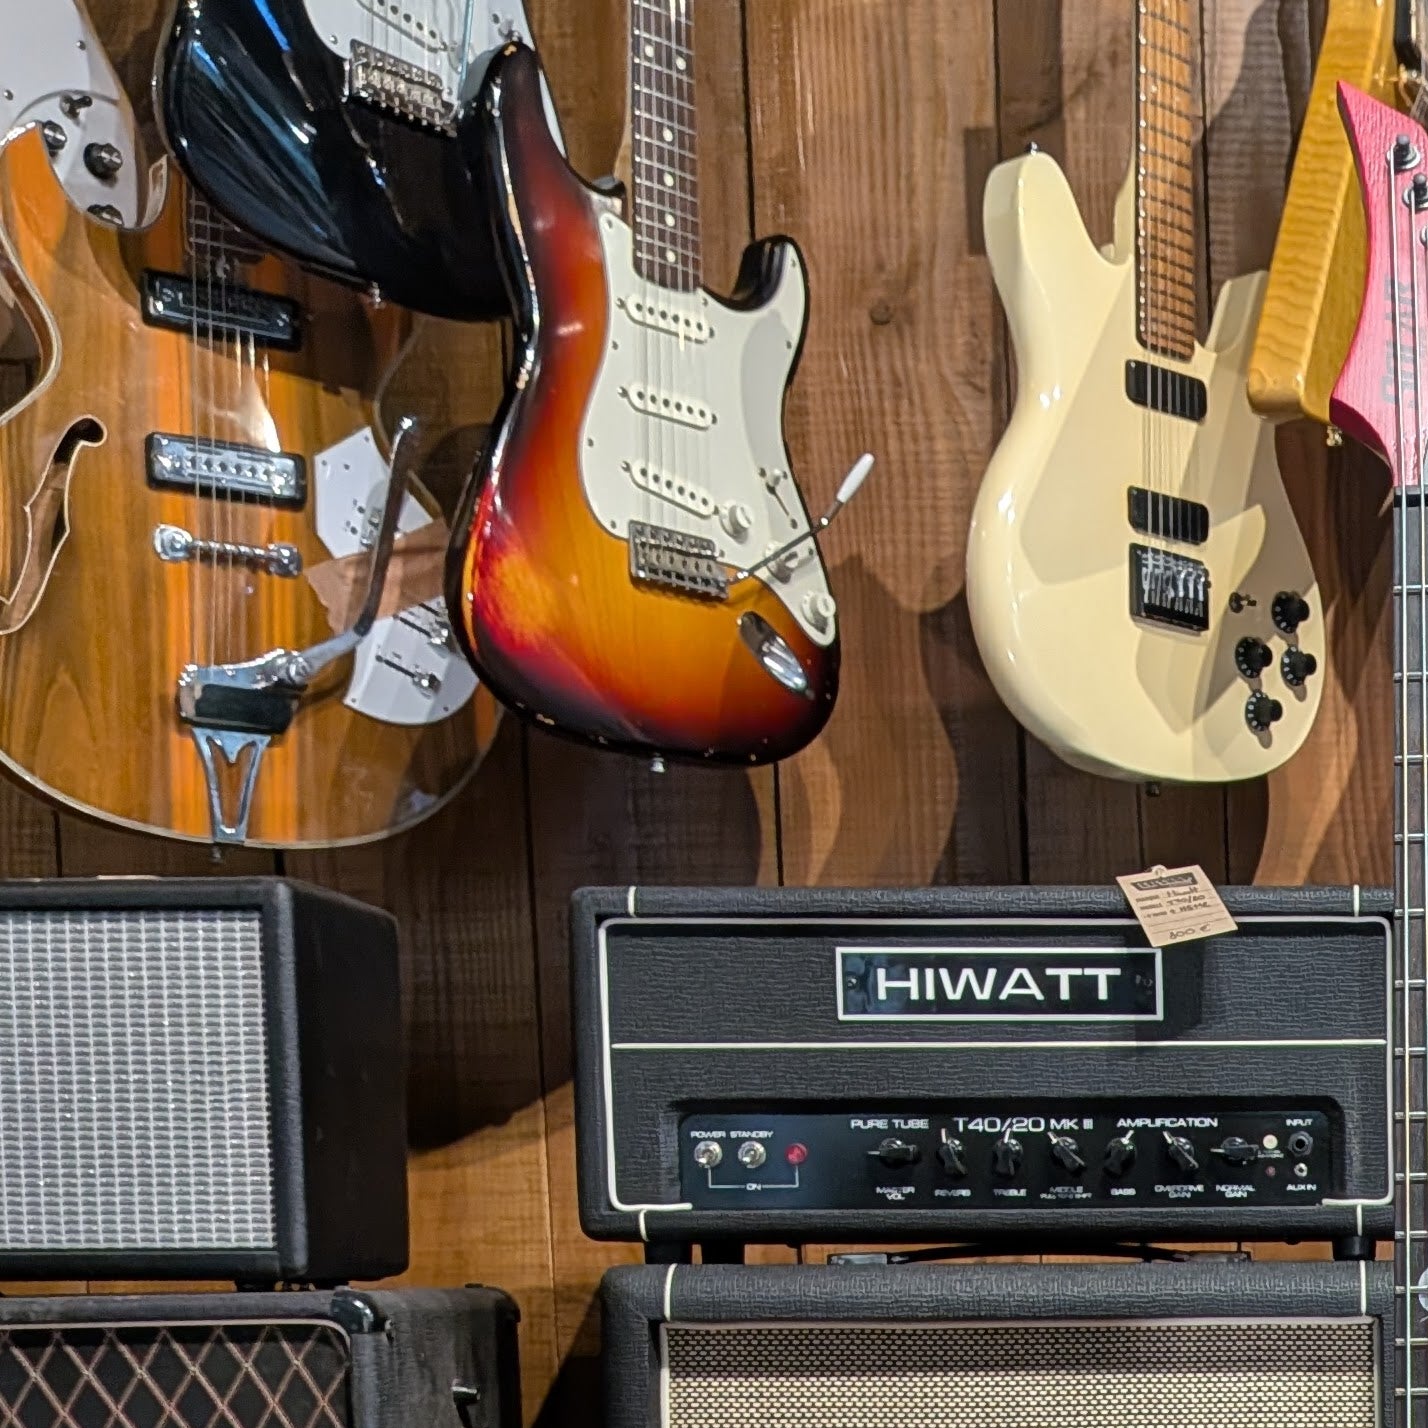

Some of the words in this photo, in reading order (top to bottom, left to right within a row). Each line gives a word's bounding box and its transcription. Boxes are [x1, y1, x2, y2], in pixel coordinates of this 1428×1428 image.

[1169, 927, 1196, 940] 800
[877, 967, 1121, 1001] HIWATT
[850, 1118, 888, 1129] PURE
[892, 1118, 930, 1129] TUBE
[952, 1117, 1045, 1133] T40/20
[1050, 1118, 1078, 1130] MK
[1116, 1117, 1219, 1128] AMPLIFICATION
[1286, 1118, 1313, 1126] INPUT
[690, 1131, 726, 1139] POWER
[730, 1131, 774, 1139] STANDBY
[746, 1182, 762, 1191] ON
